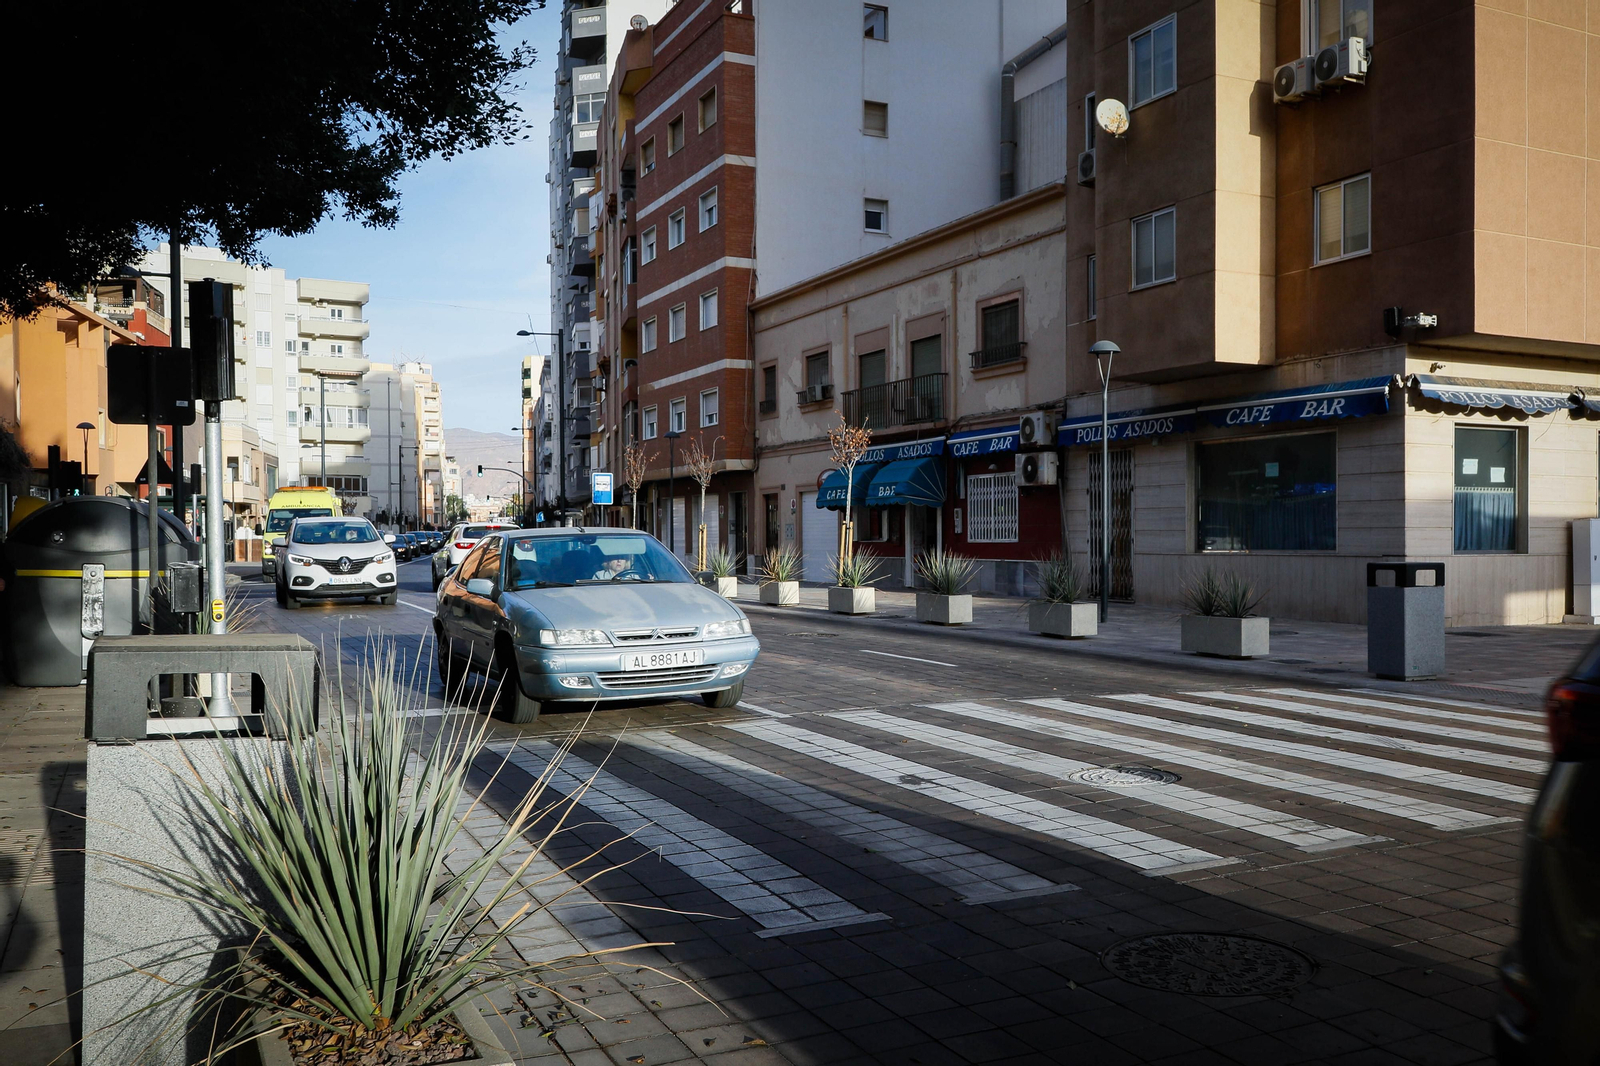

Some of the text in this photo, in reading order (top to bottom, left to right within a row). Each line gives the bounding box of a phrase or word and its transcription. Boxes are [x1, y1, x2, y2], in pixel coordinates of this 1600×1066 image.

[1436, 389, 1506, 405] POLLOS
[1226, 398, 1346, 425] CAFE BAR
[1076, 417, 1174, 443] POLLOS ASADOS
[856, 442, 933, 463] OLLOS ASADOS
[953, 436, 1013, 456] CAFE BAR
[826, 489, 846, 500] CAFE
[633, 651, 696, 668] AL 8881 AJ
